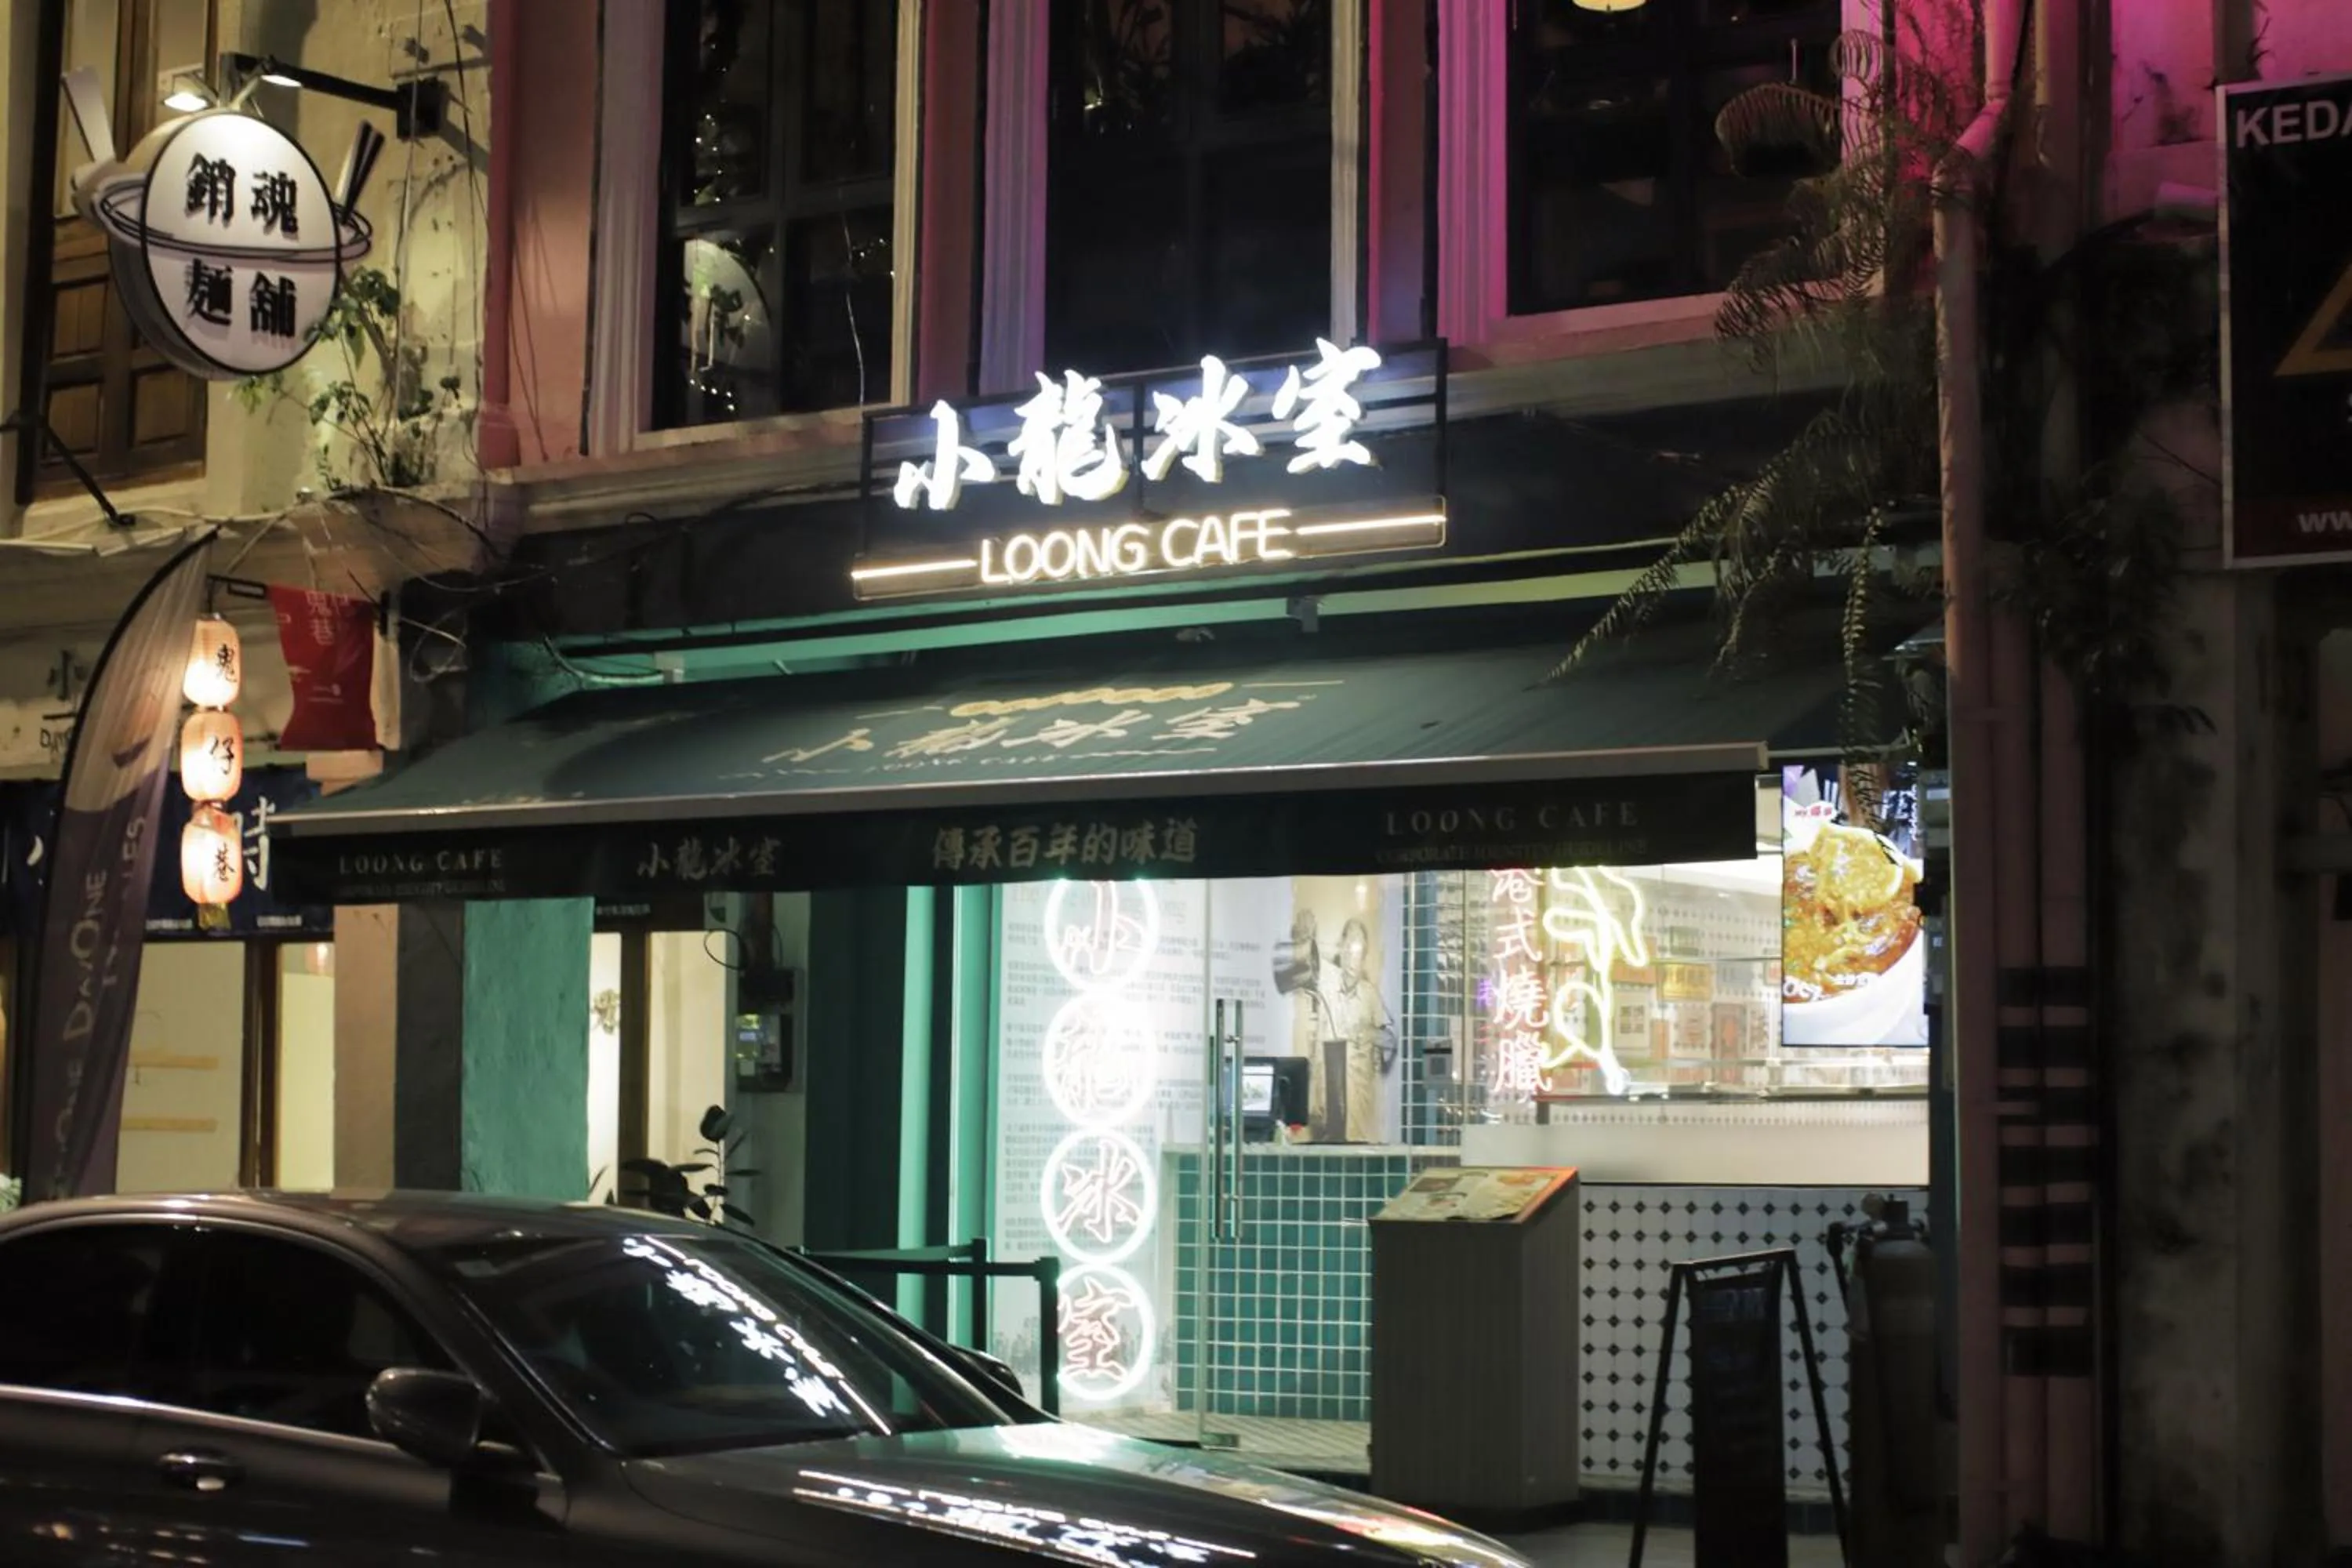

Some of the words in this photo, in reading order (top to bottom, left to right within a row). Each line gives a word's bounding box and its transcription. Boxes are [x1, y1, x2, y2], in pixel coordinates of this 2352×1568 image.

[894, 337, 1382, 510] 小龍冰室
[980, 524, 1150, 584] LOONG
[1161, 508, 1294, 567] CAFE
[1385, 807, 1516, 836] LOONG
[1538, 800, 1639, 829] CAFE
[339, 854, 424, 876] LOONG
[437, 847, 504, 871] CAFE
[637, 836, 782, 880] 小龍冰室
[933, 816, 1198, 870] 傳承百年的味道
